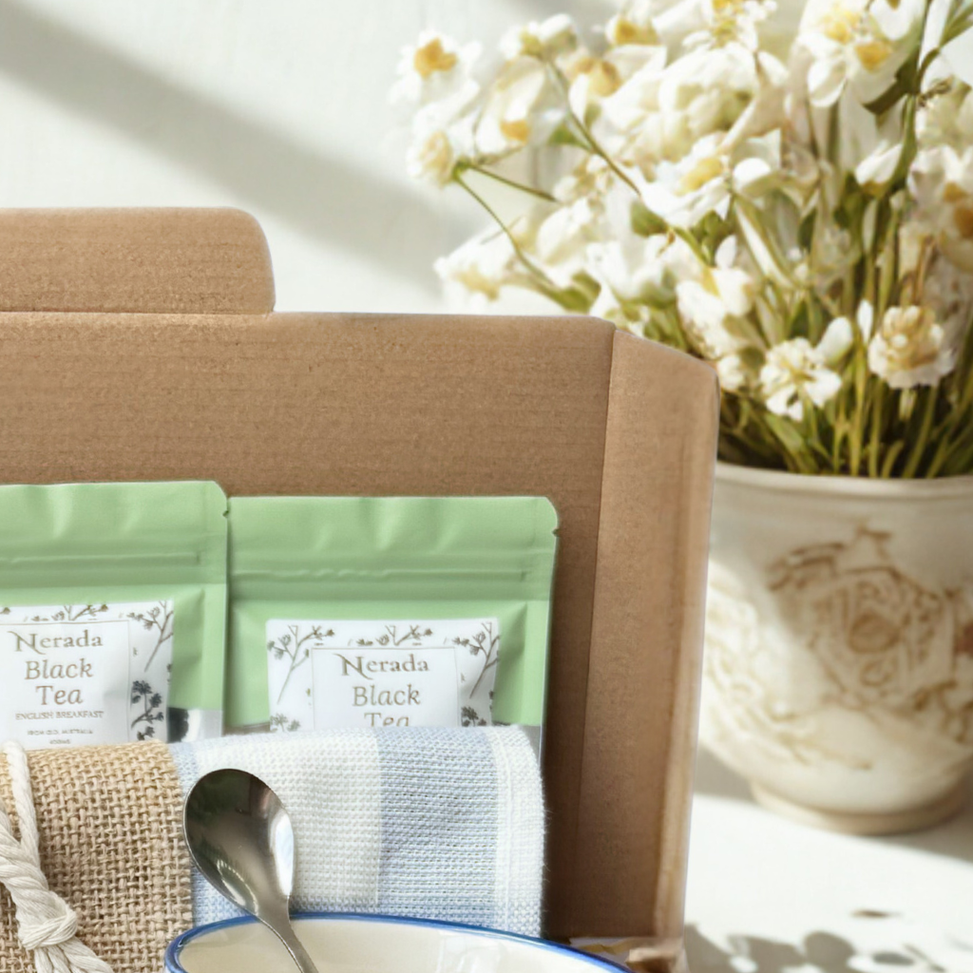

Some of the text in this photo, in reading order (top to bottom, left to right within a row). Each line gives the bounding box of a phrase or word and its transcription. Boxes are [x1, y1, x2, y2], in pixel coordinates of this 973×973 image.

[7, 629, 103, 655] Nerada
[24, 658, 94, 680] Black
[332, 653, 430, 680] Nerada
[35, 685, 84, 705] Tea
[352, 683, 421, 707] Black
[15, 710, 105, 720] ENGLISH BREAKFAST
